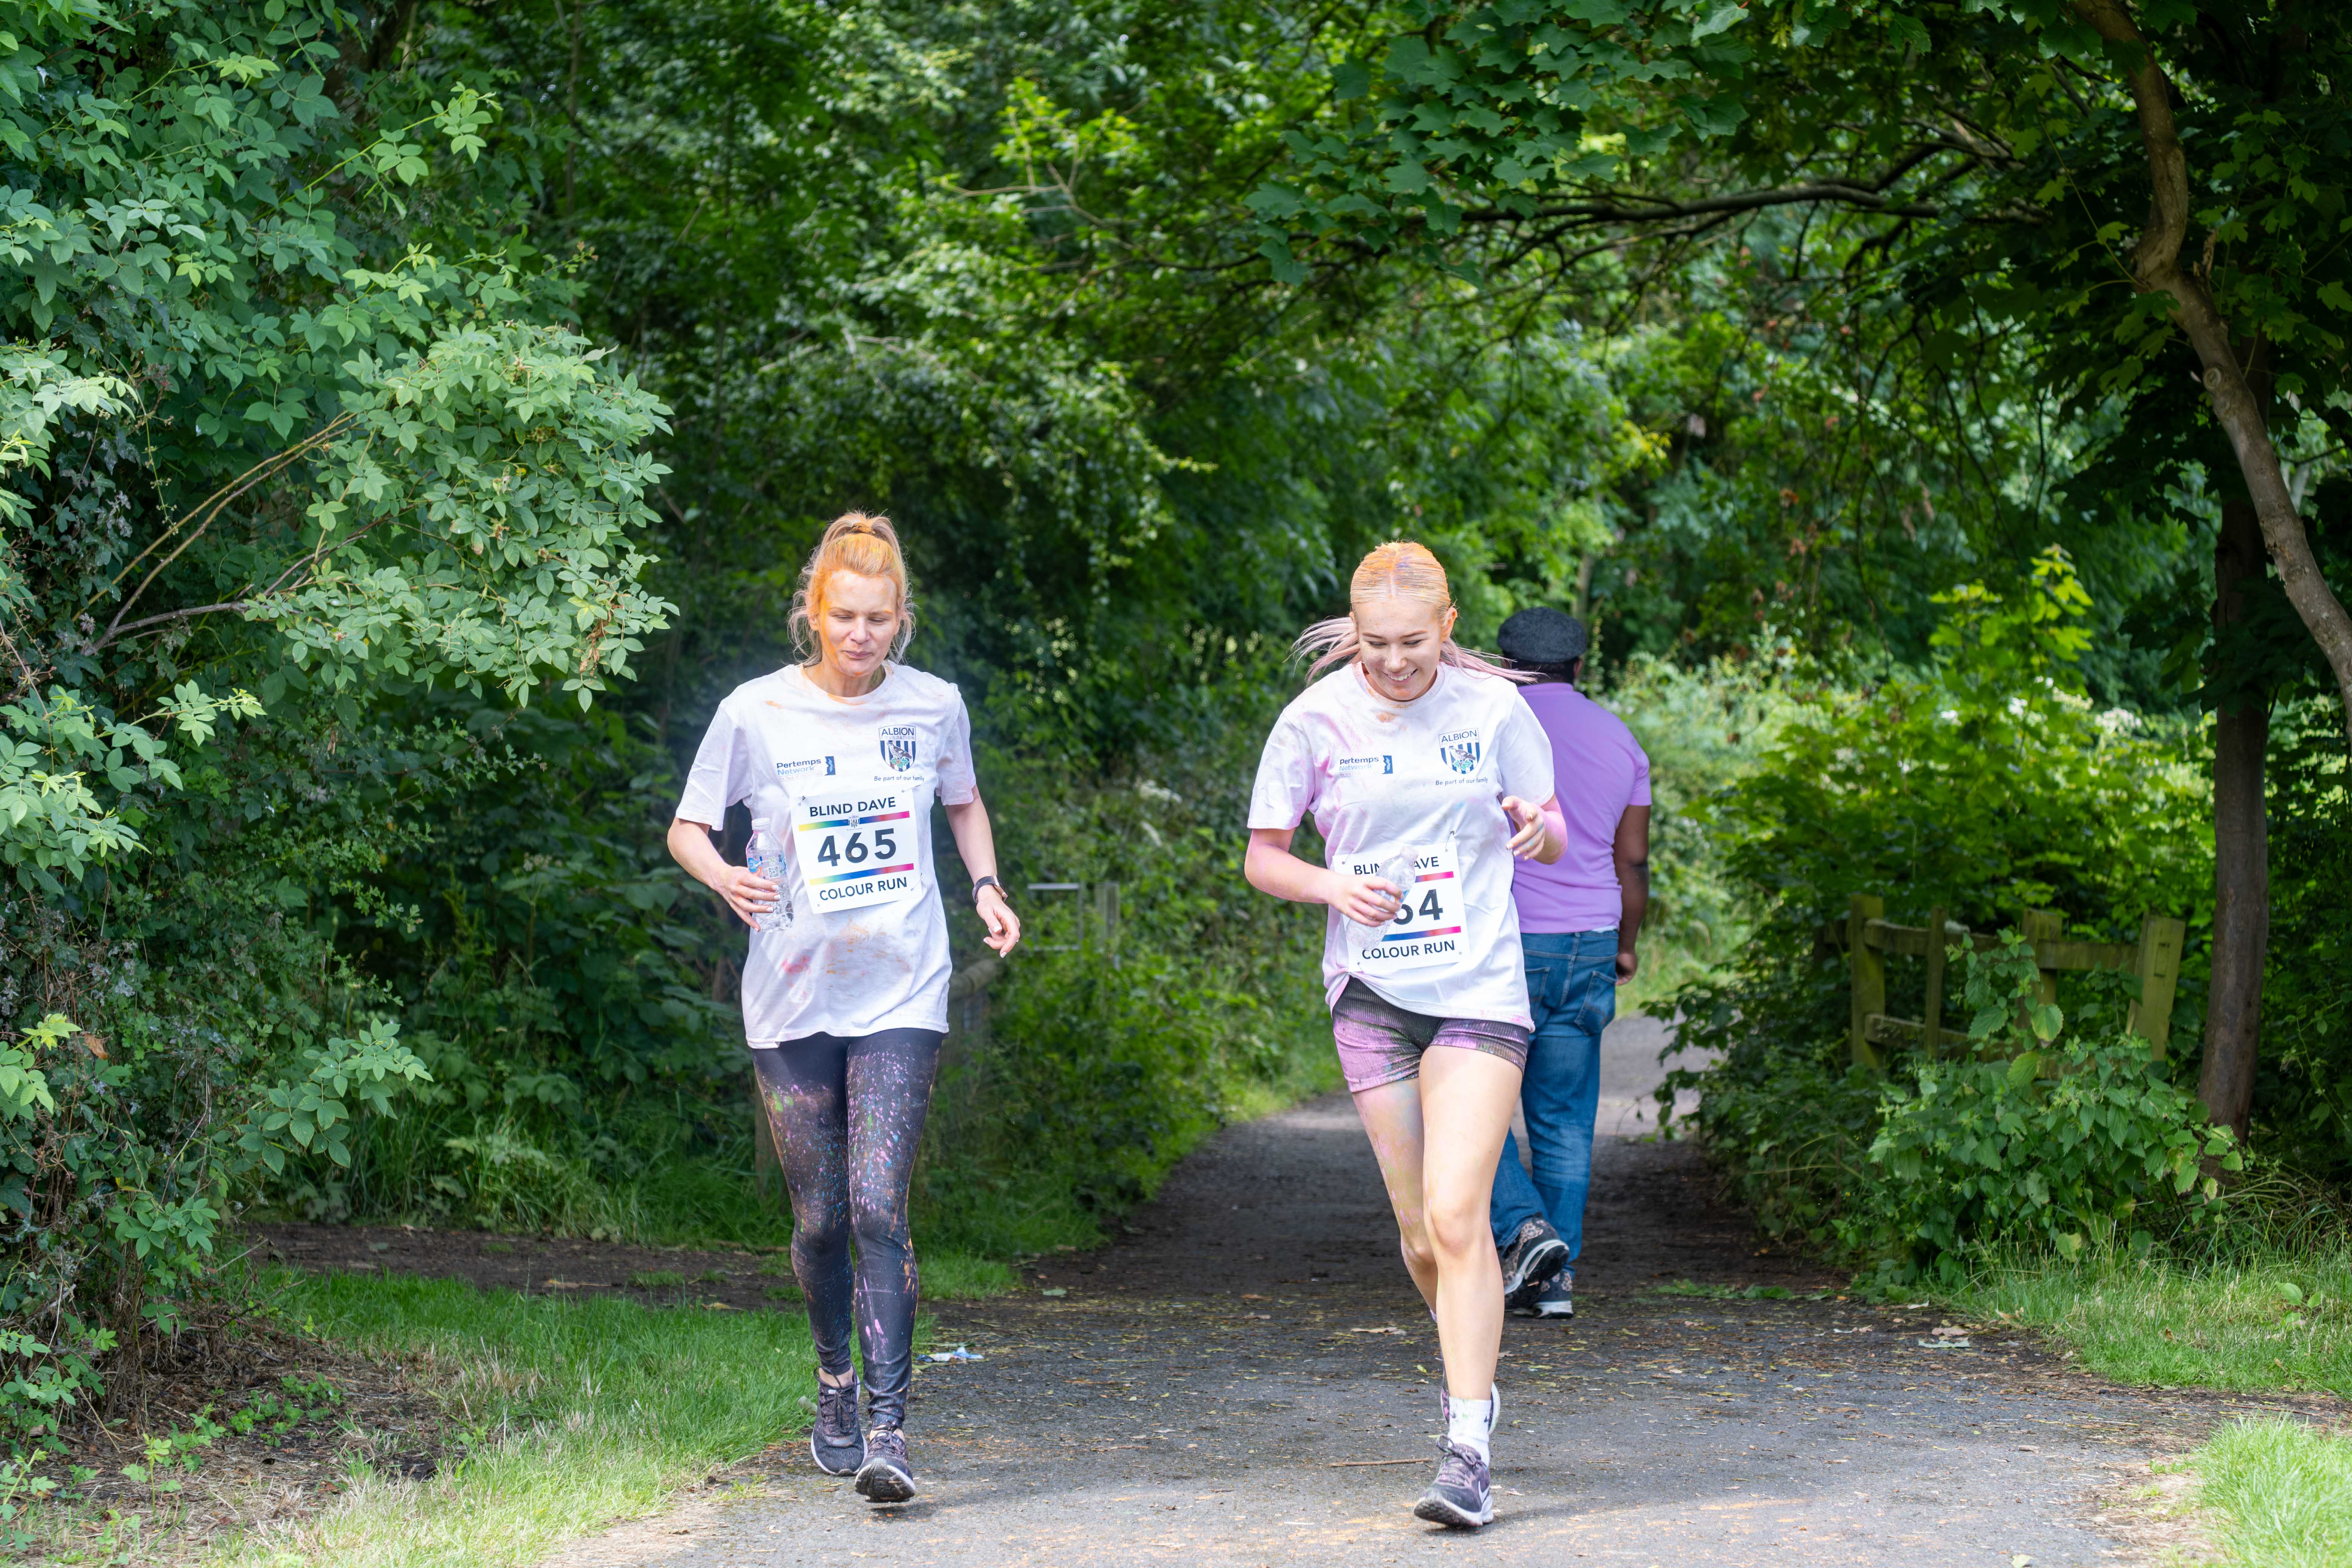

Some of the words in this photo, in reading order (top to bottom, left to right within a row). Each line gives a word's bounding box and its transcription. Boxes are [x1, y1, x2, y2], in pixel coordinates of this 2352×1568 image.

[881, 727, 914, 736] ALBION
[1441, 730, 1477, 743] ALBION
[776, 759, 821, 769] Pertemps
[777, 766, 815, 775] Network
[809, 803, 853, 817] BLIND
[858, 797, 896, 812] DAVE
[818, 828, 896, 867] 465
[1354, 863, 1382, 875] BLIN
[1414, 856, 1439, 869] AVE
[819, 882, 874, 900] COLOUR
[877, 877, 907, 891] RUN
[1393, 889, 1443, 925] 64
[1362, 945, 1420, 959] COLOUR
[1424, 940, 1455, 954] RUN
